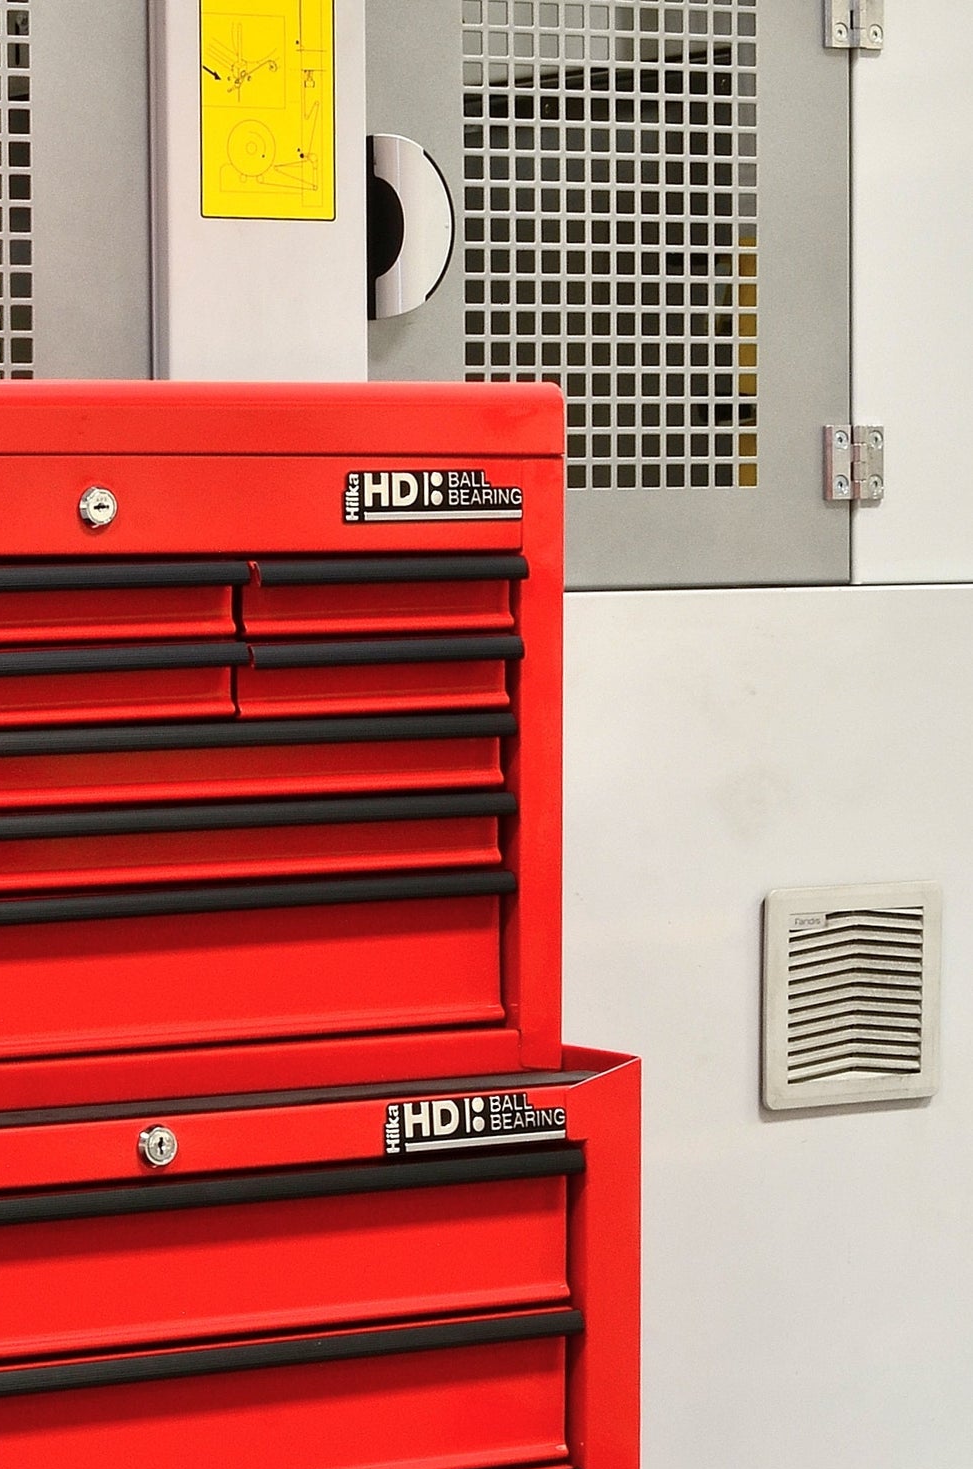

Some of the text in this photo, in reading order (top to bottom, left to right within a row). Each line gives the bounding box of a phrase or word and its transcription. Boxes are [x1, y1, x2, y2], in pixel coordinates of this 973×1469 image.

[448, 471, 490, 488] BALL
[345, 474, 360, 521] Hilka
[448, 488, 523, 506] BEARING
[489, 1093, 533, 1113] BALL
[385, 1104, 400, 1154] Hilka
[490, 1108, 566, 1131] BEARING
